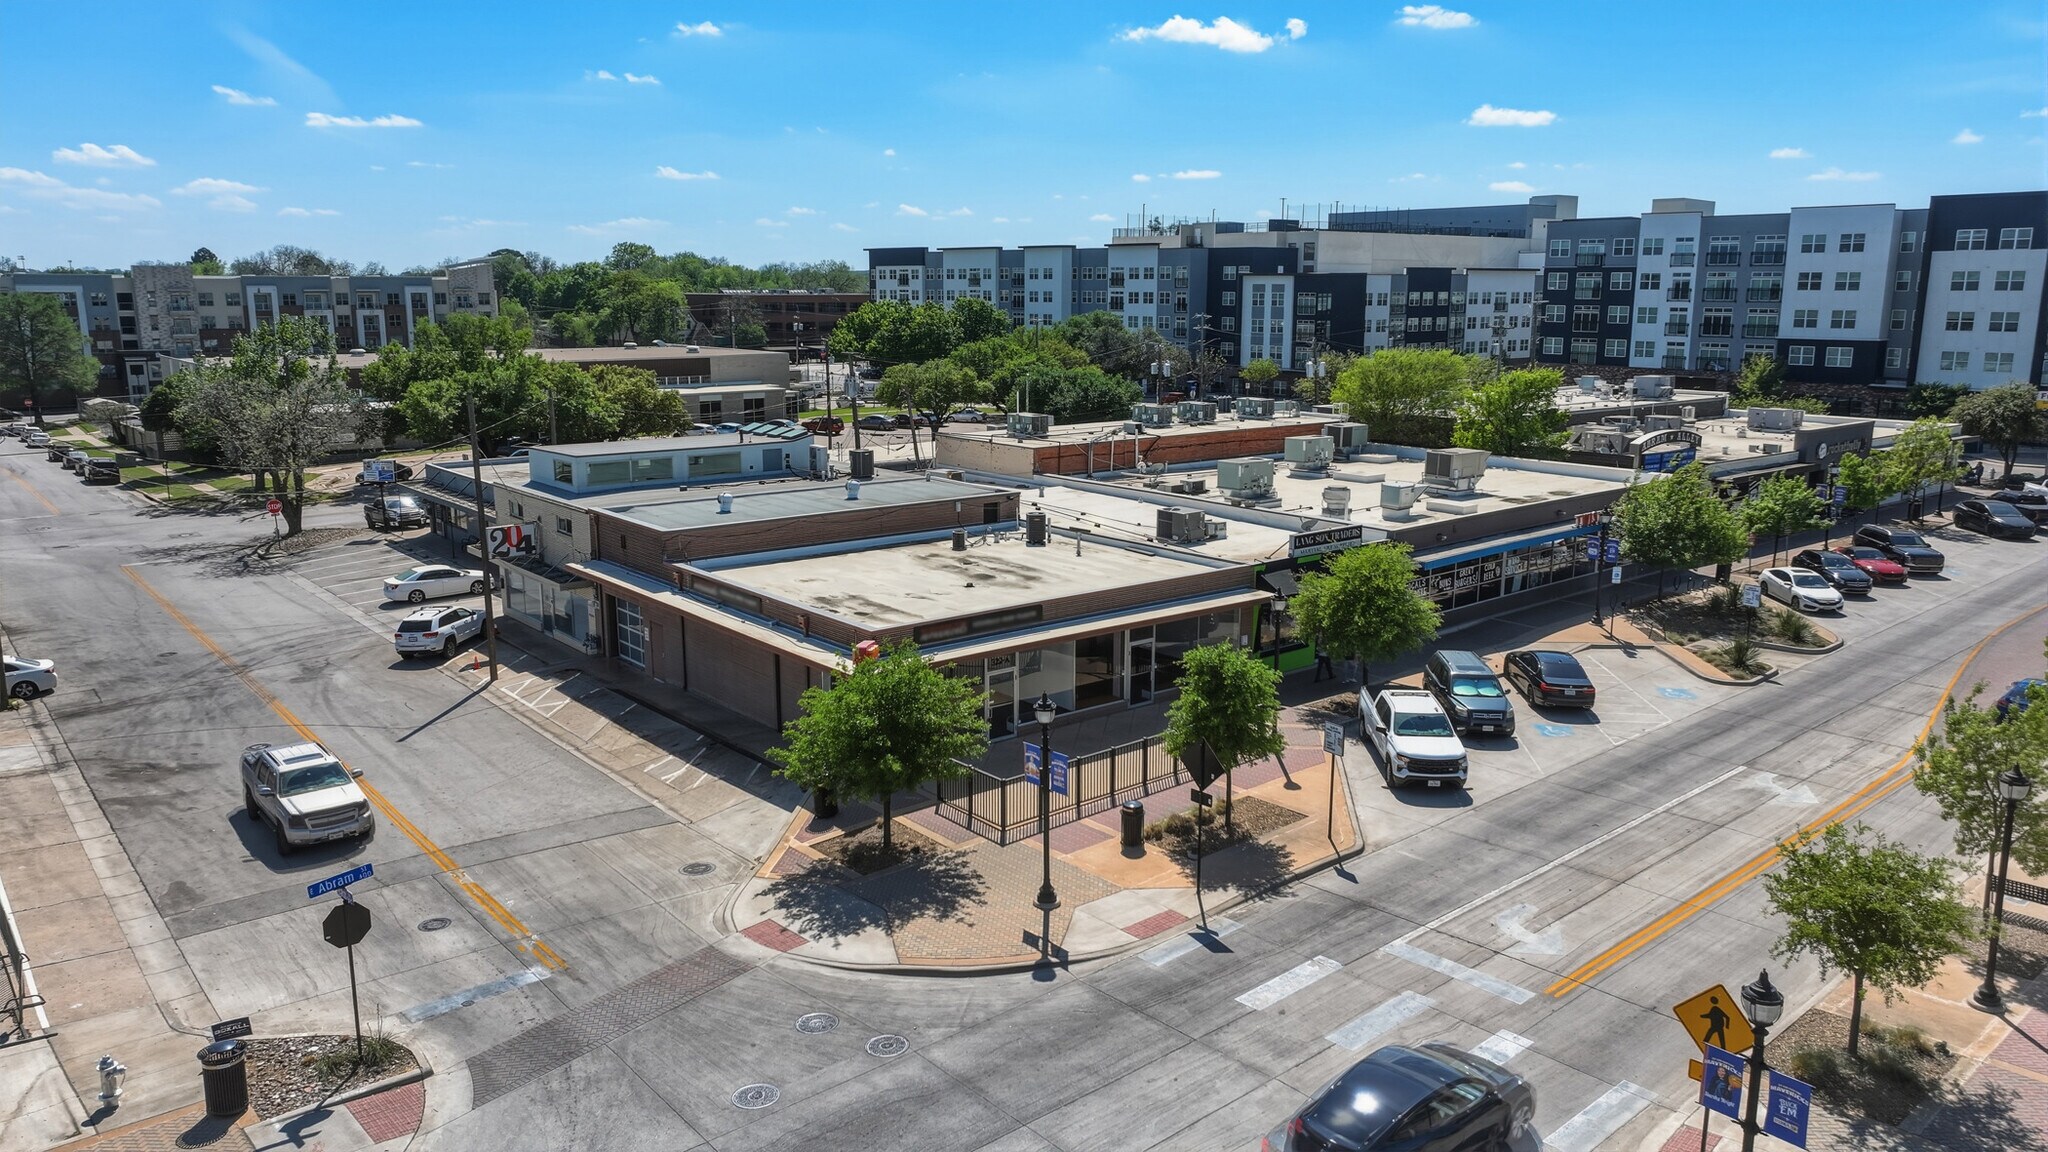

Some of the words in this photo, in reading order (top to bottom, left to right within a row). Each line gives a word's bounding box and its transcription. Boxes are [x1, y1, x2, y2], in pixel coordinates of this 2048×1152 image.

[1643, 434, 1668, 450] ABRAM
[1677, 432, 1700, 444] ALLEY
[490, 525, 537, 559] 204
[1296, 535, 1315, 547] LANG
[1330, 528, 1361, 541] TRADERS
[1483, 571, 1495, 582] BEER
[318, 873, 355, 894] Abram
[1770, 1085, 1809, 1107] MAVERICKS
